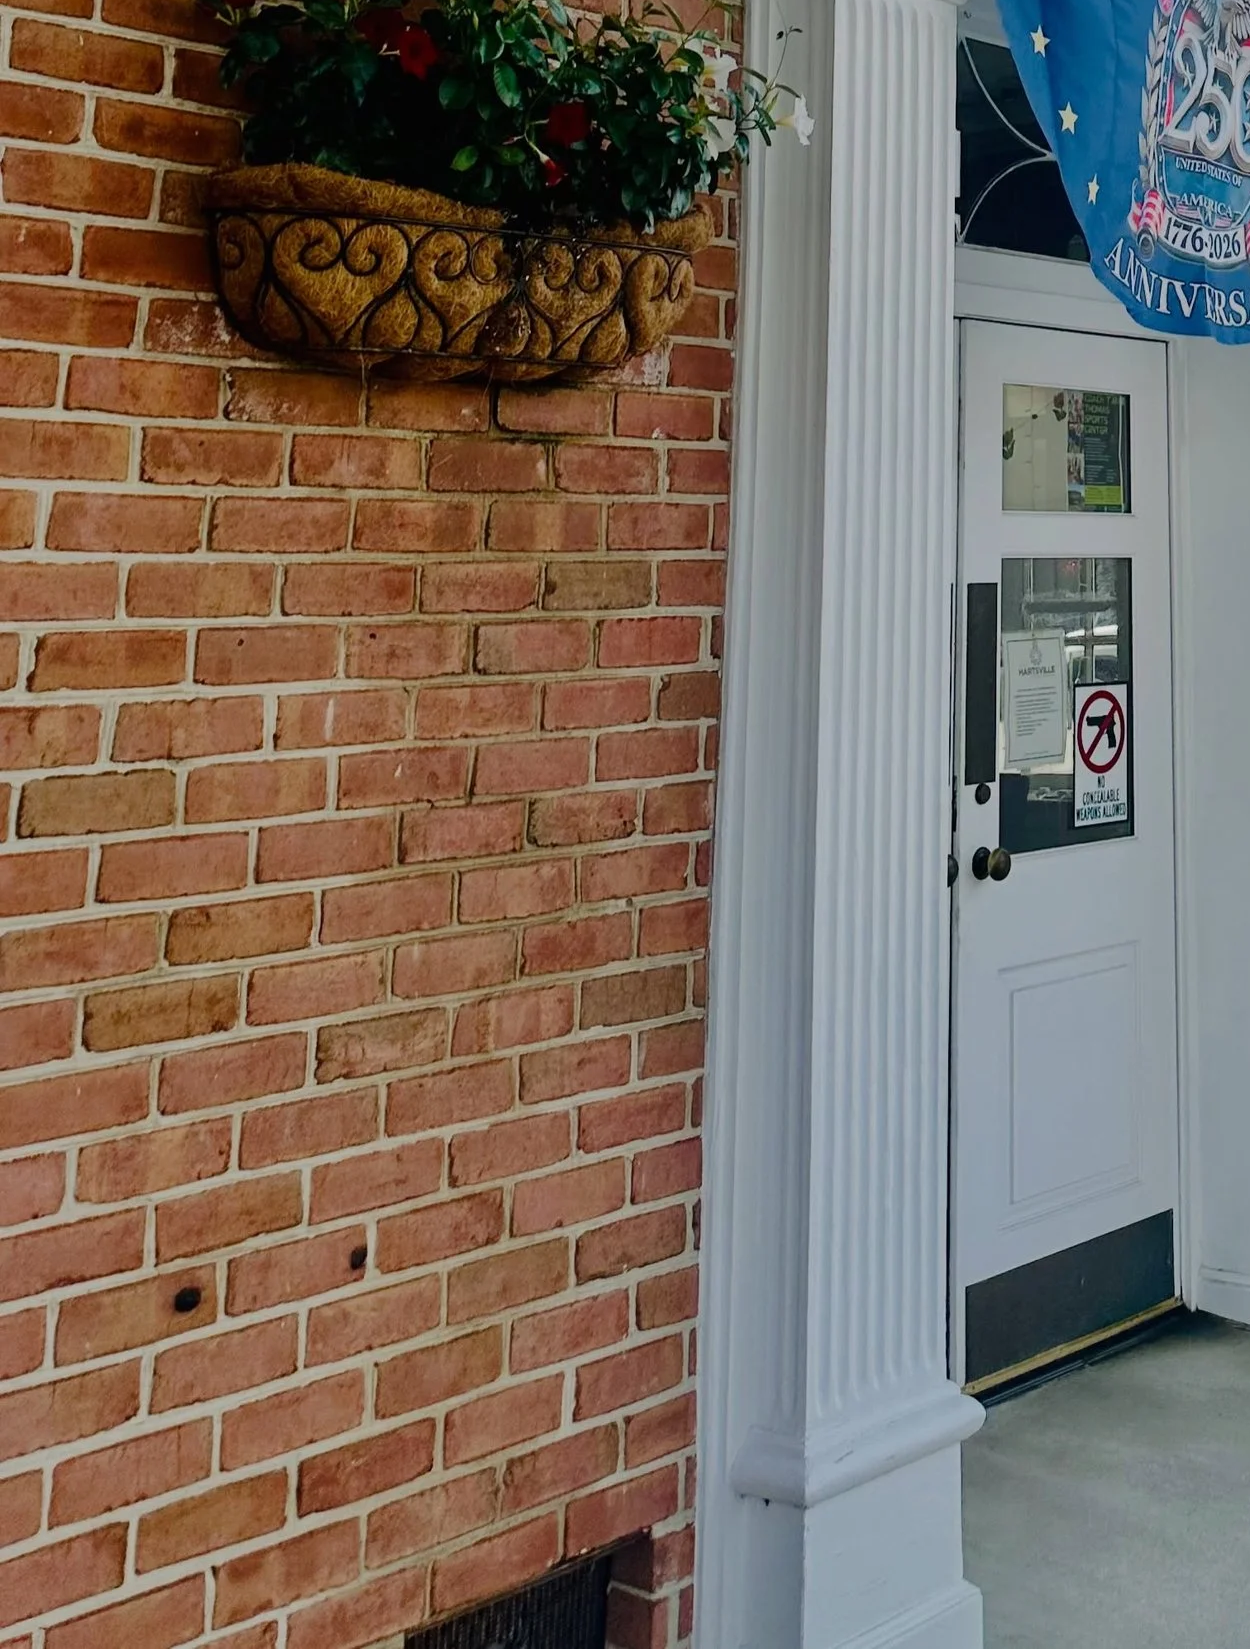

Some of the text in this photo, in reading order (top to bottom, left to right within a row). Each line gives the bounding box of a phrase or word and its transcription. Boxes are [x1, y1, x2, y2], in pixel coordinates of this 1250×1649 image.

[1175, 156, 1243, 187] UNITED STATES OF
[1180, 192, 1233, 218] AMERICA
[1097, 775, 1105, 788] NO
[1082, 788, 1120, 806] CONCEALABLE
[1076, 802, 1127, 821] WEAPONS ALLOWED
